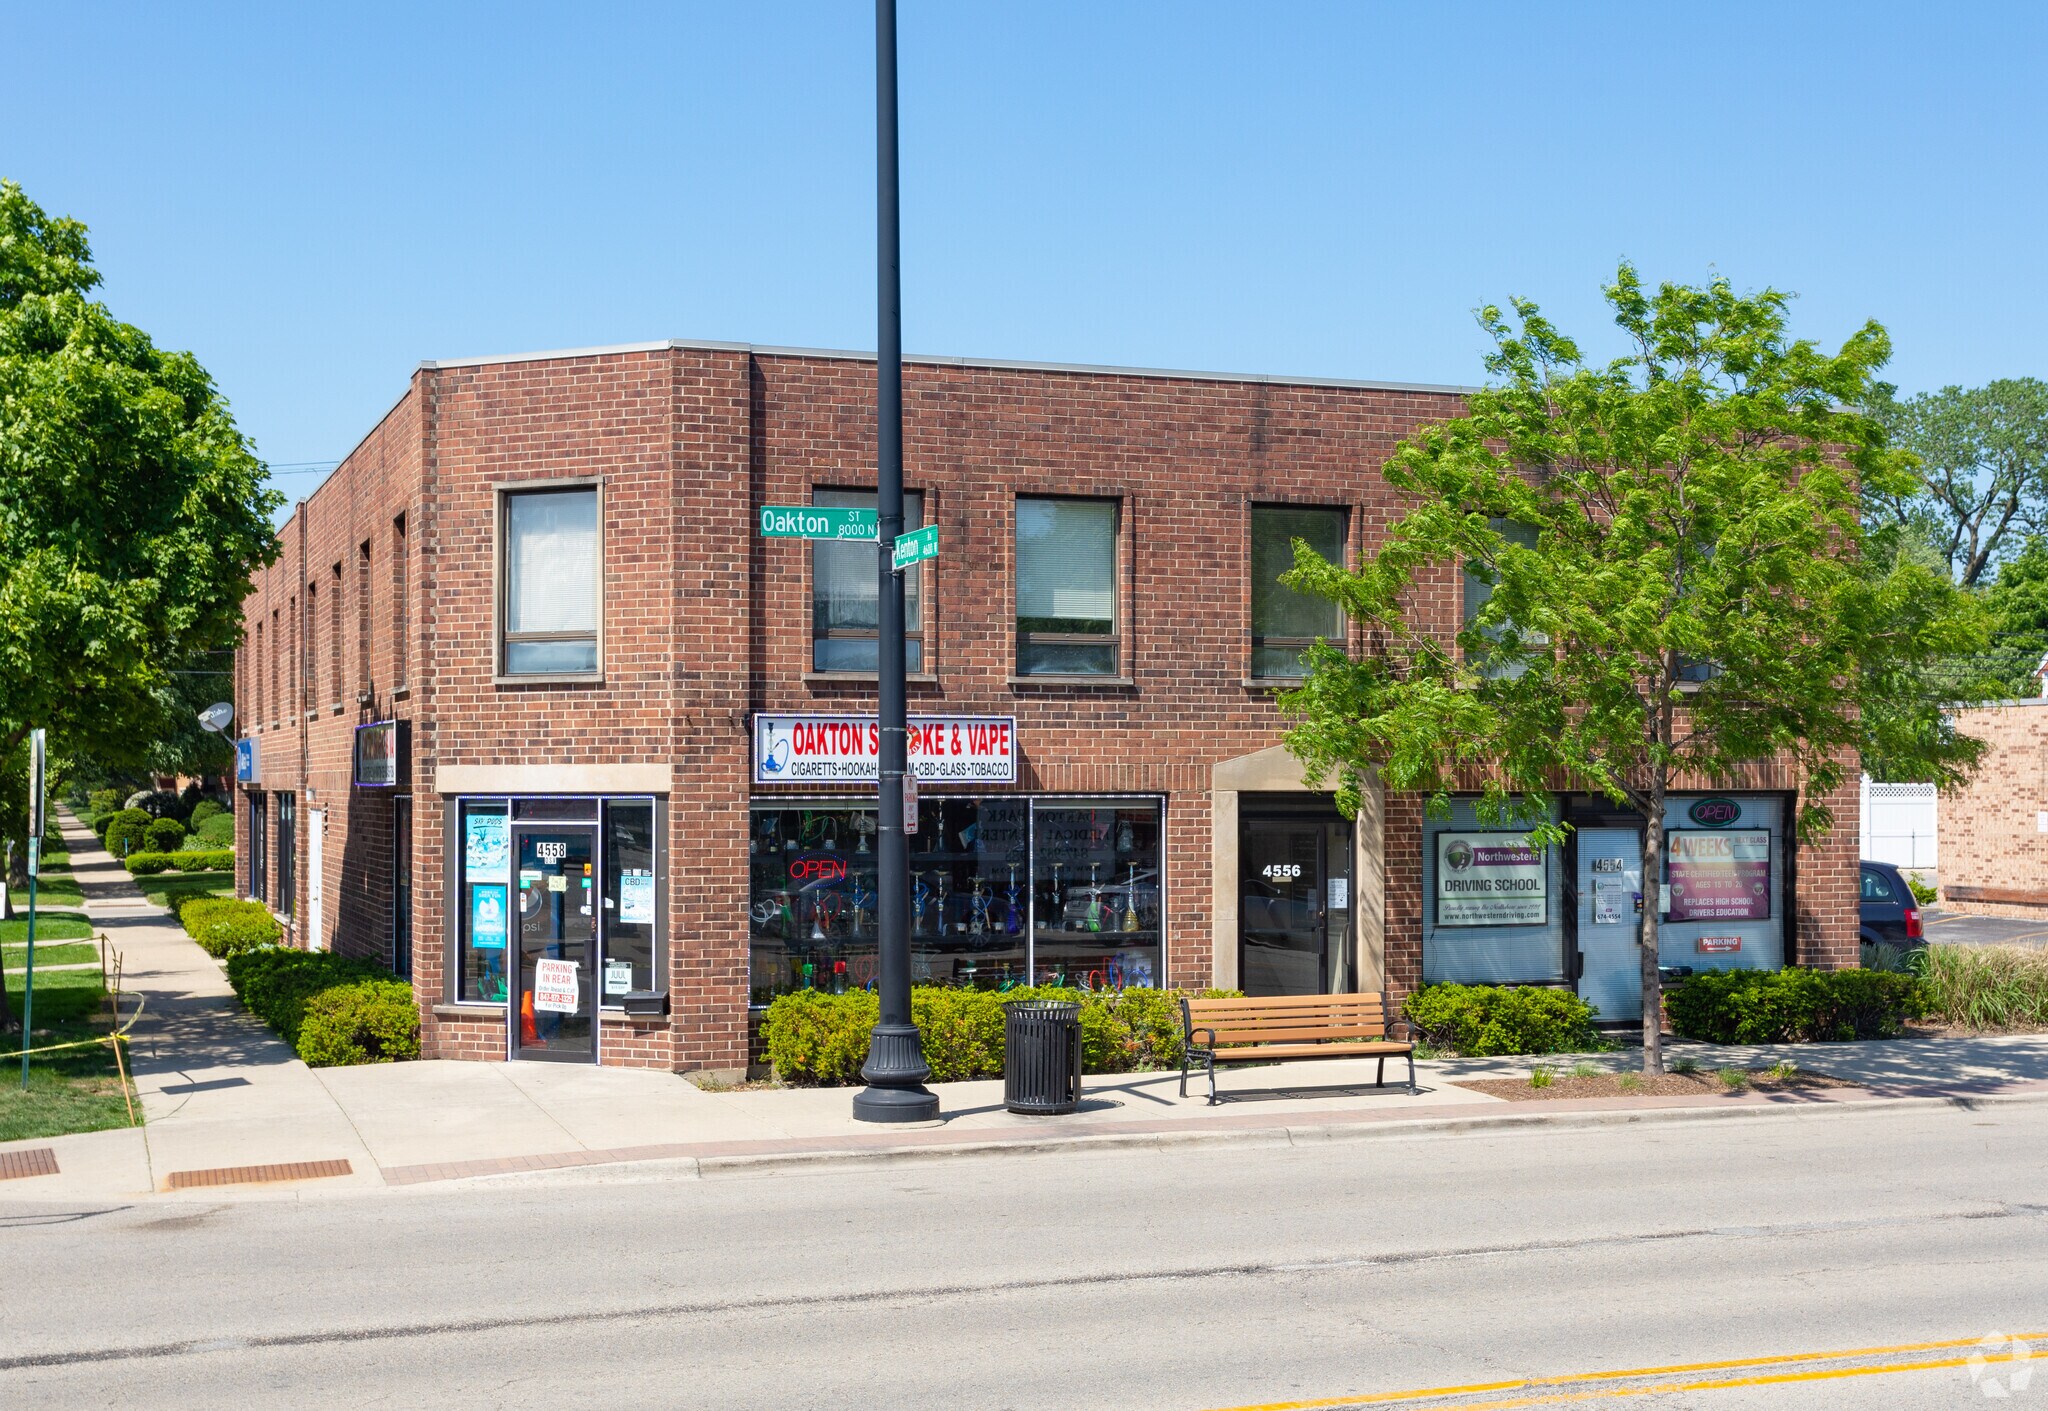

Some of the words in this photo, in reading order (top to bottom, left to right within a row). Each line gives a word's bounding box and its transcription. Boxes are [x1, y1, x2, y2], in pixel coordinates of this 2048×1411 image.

[762, 510, 829, 534] Oakton
[848, 511, 860, 522] ST
[838, 524, 864, 536] 8000
[867, 524, 875, 535] N
[896, 537, 918, 560] Kenton
[792, 722, 863, 756] OAKTON
[869, 723, 945, 756] SKE
[950, 723, 963, 756] &
[967, 723, 1009, 756] VAPE
[1695, 804, 1735, 821] OPEN
[1749, 836, 1767, 844] CLASS
[538, 843, 565, 857] 4558
[1670, 836, 1681, 857] 4
[1683, 837, 1733, 857] WEEKS
[790, 860, 847, 879] OPEN
[1262, 864, 1301, 877] 4556
[1596, 859, 1622, 872] 4554
[1671, 870, 1689, 878] STATE
[1690, 870, 1720, 878] CERTIFIED
[1737, 869, 1766, 878] PROGRAM
[625, 877, 641, 886] CBD
[1445, 879, 1492, 892] DRIVING
[1494, 878, 1541, 891] SCHOOL
[1695, 880, 1711, 889] AGES
[1714, 880, 1722, 888] 15
[1725, 880, 1732, 888] TO
[1683, 898, 1714, 906] REPLACES
[1731, 897, 1754, 905] SCHOOL
[1444, 911, 1540, 920] www.northwesterndriving.com
[1689, 908, 1715, 917] DRIVERS
[1716, 908, 1749, 916] EDUCATION
[522, 921, 540, 934] psi
[1702, 937, 1738, 946] PARKING
[542, 962, 573, 974] PARKING
[543, 973, 550, 983] IN
[551, 974, 571, 985] REAR
